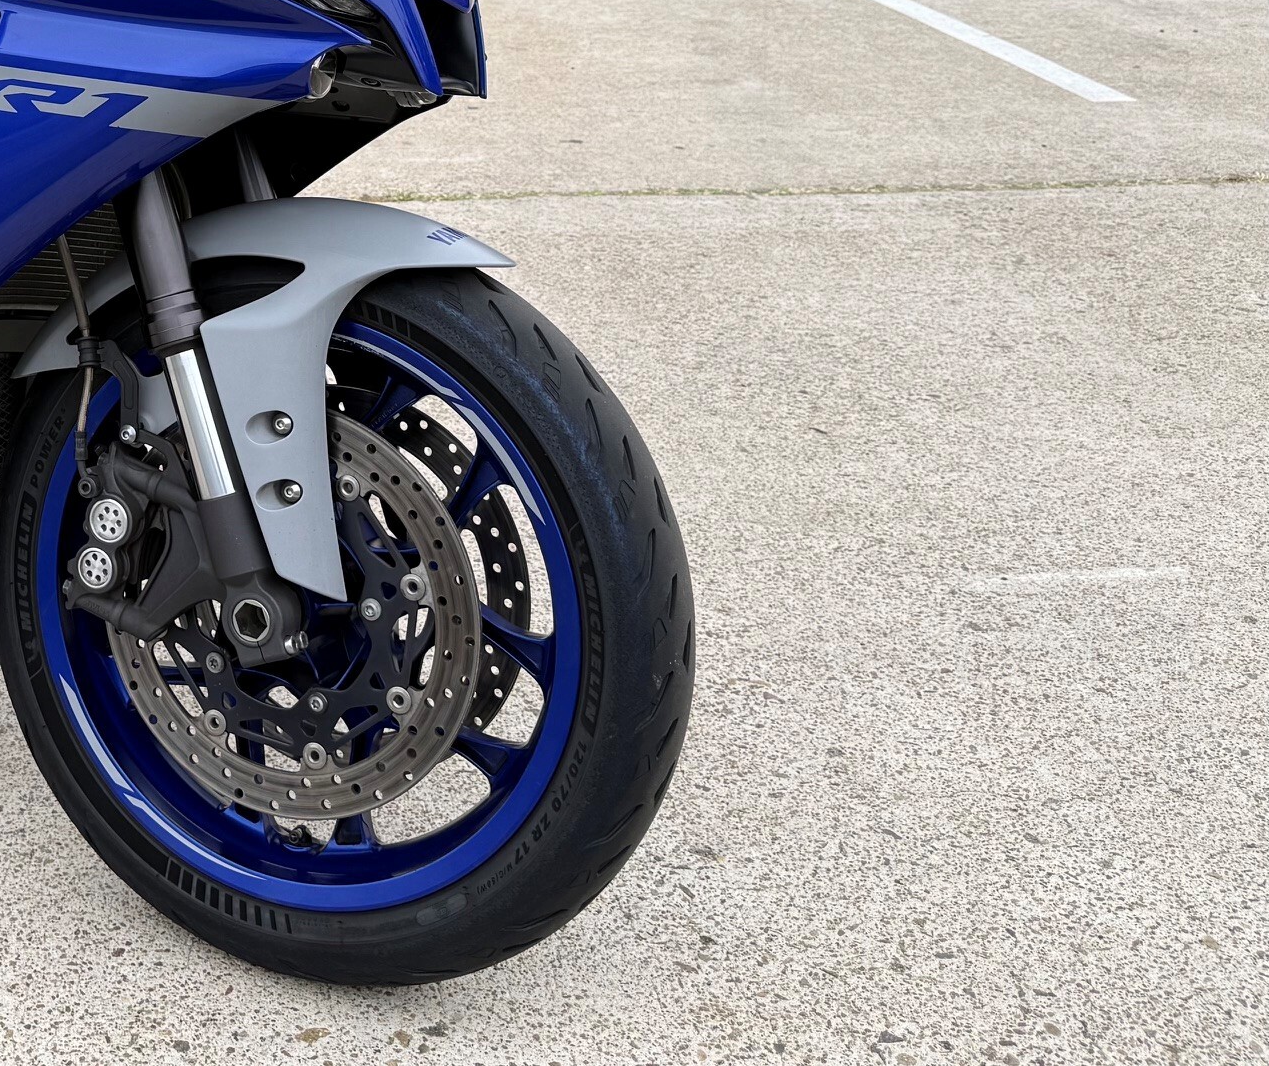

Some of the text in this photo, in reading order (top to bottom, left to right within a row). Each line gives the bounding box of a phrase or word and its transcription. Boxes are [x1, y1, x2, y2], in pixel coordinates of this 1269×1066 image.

[17, 414, 66, 632] MICHELIN POWER
[582, 570, 605, 722] MICHELIN
[551, 741, 588, 812] 120/70
[514, 840, 530, 865] 17
[531, 812, 551, 842] ZR
